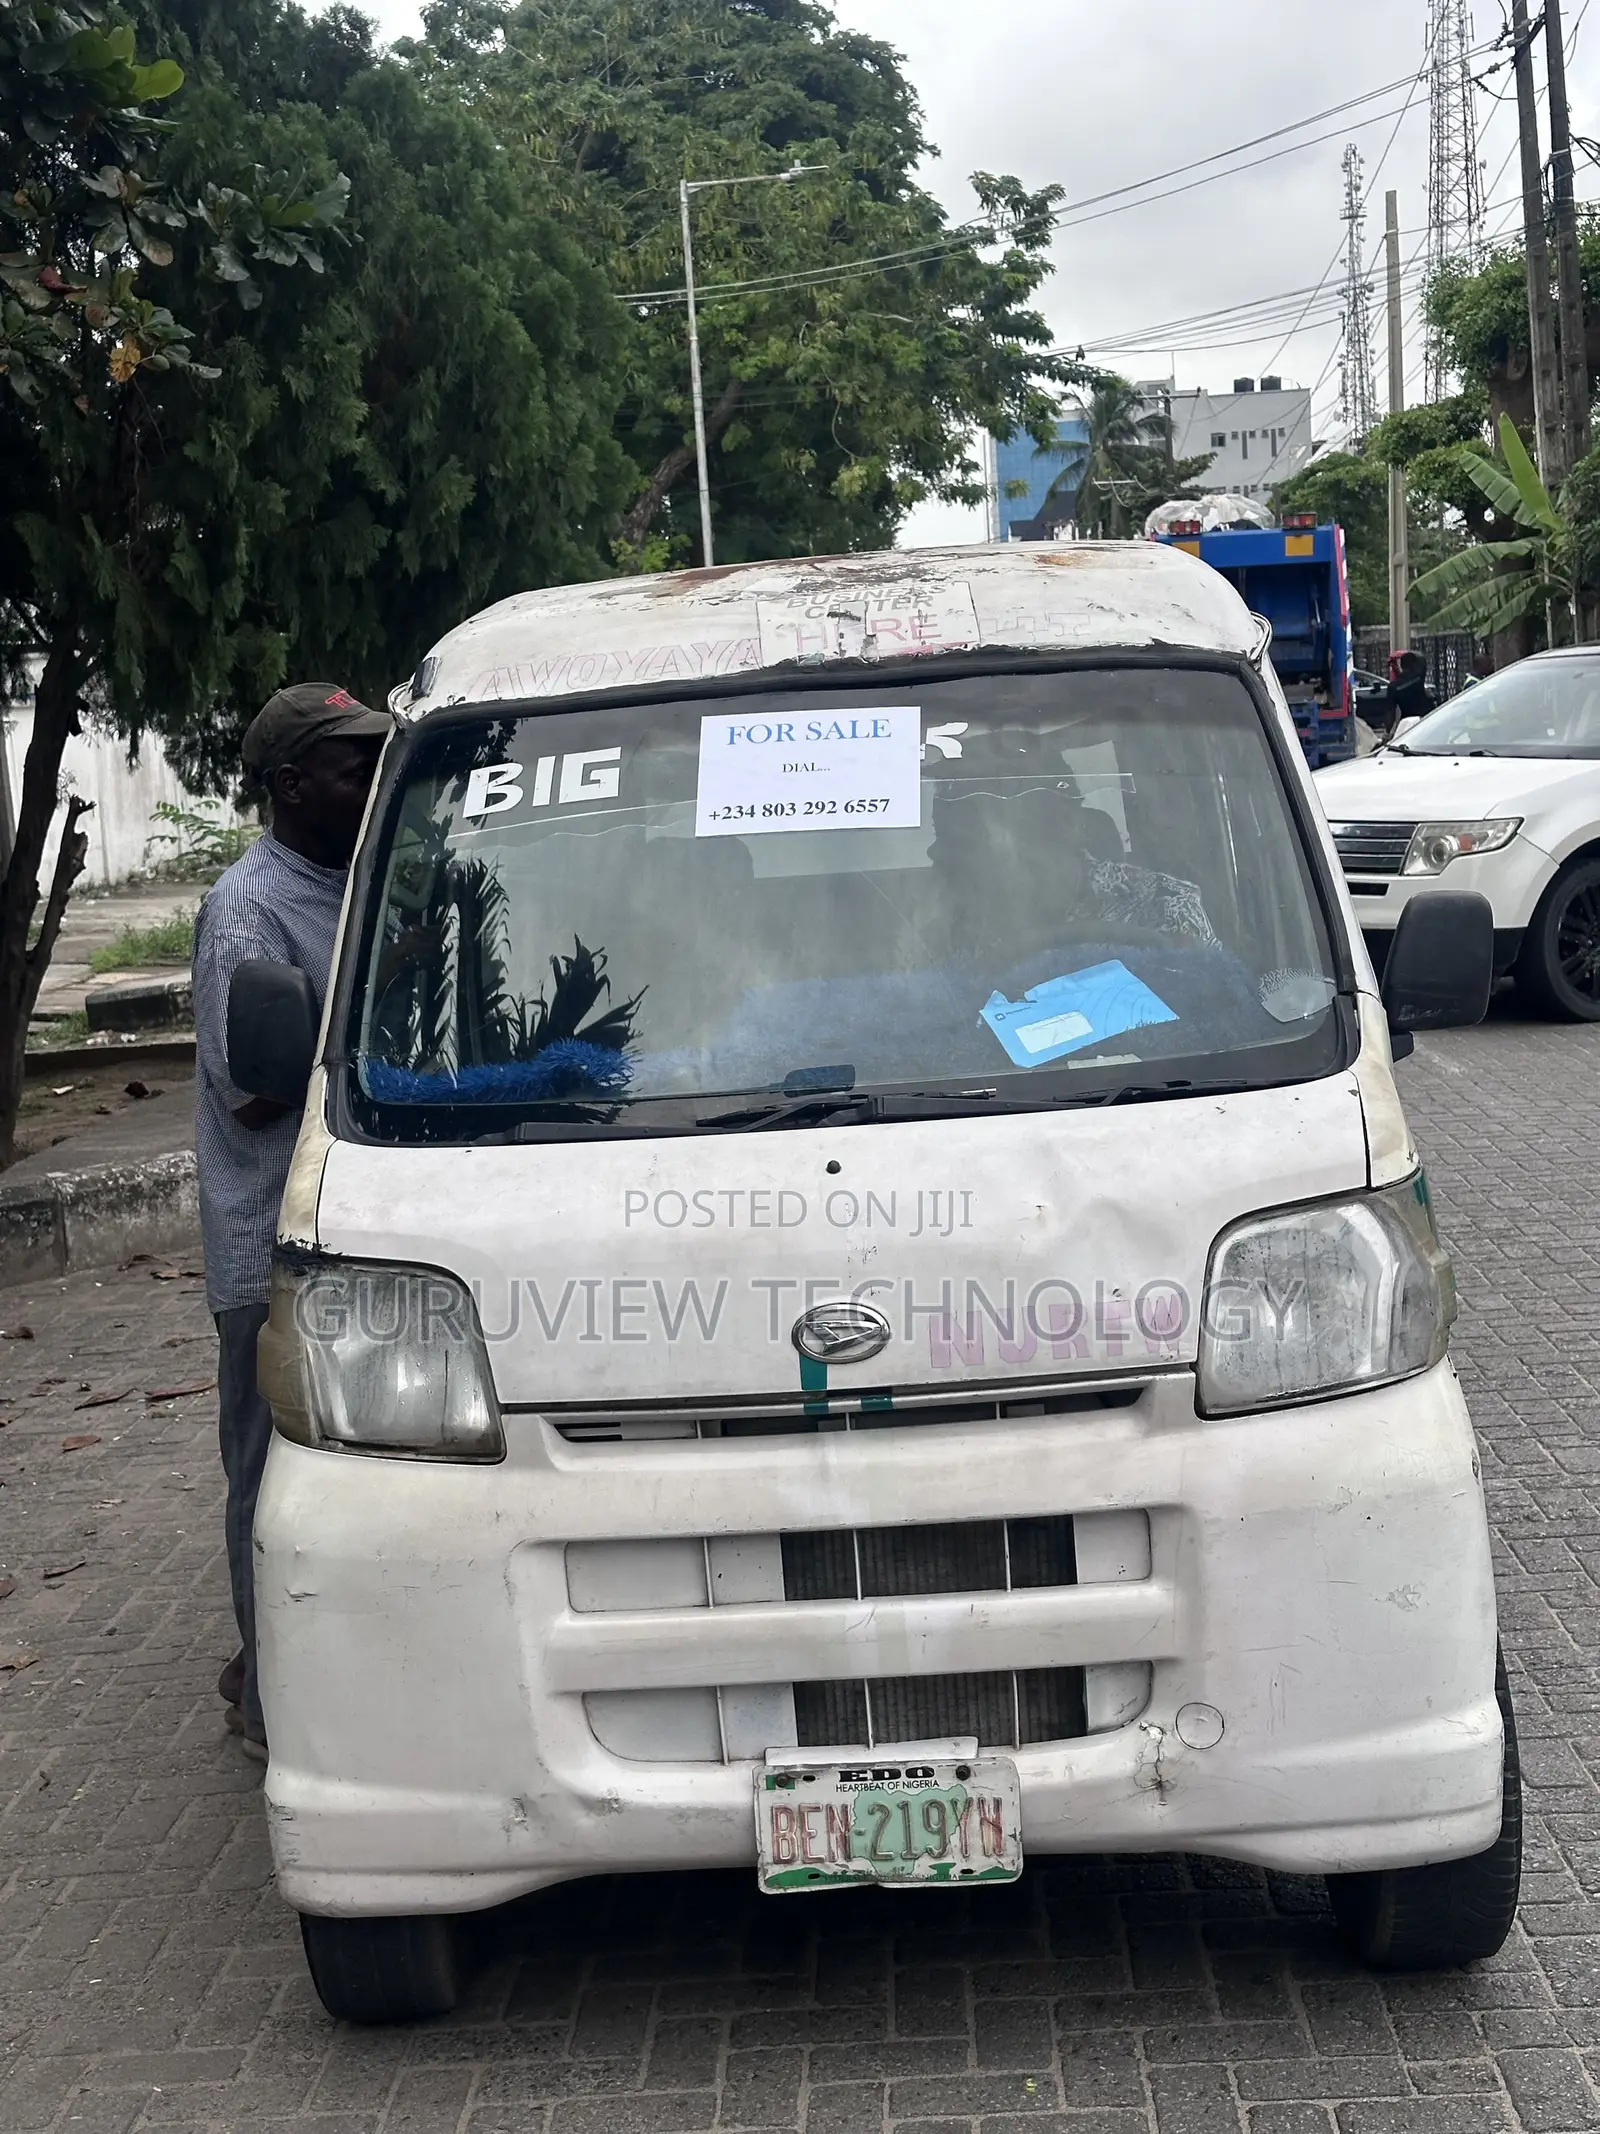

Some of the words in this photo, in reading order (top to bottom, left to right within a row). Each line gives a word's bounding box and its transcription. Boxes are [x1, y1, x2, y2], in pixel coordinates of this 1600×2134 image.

[726, 723, 796, 746] FOR
[805, 718, 892, 741] SALE
[462, 746, 622, 819] BIG
[708, 805, 756, 821] +234
[762, 802, 797, 818] 803
[802, 800, 838, 816] 292
[843, 798, 890, 814] 6557
[836, 1782, 885, 1793] HEARTBEAT
[887, 1781, 900, 1791] OF
[902, 1779, 940, 1790] NIGERIA
[839, 1766, 935, 1783] EDO
